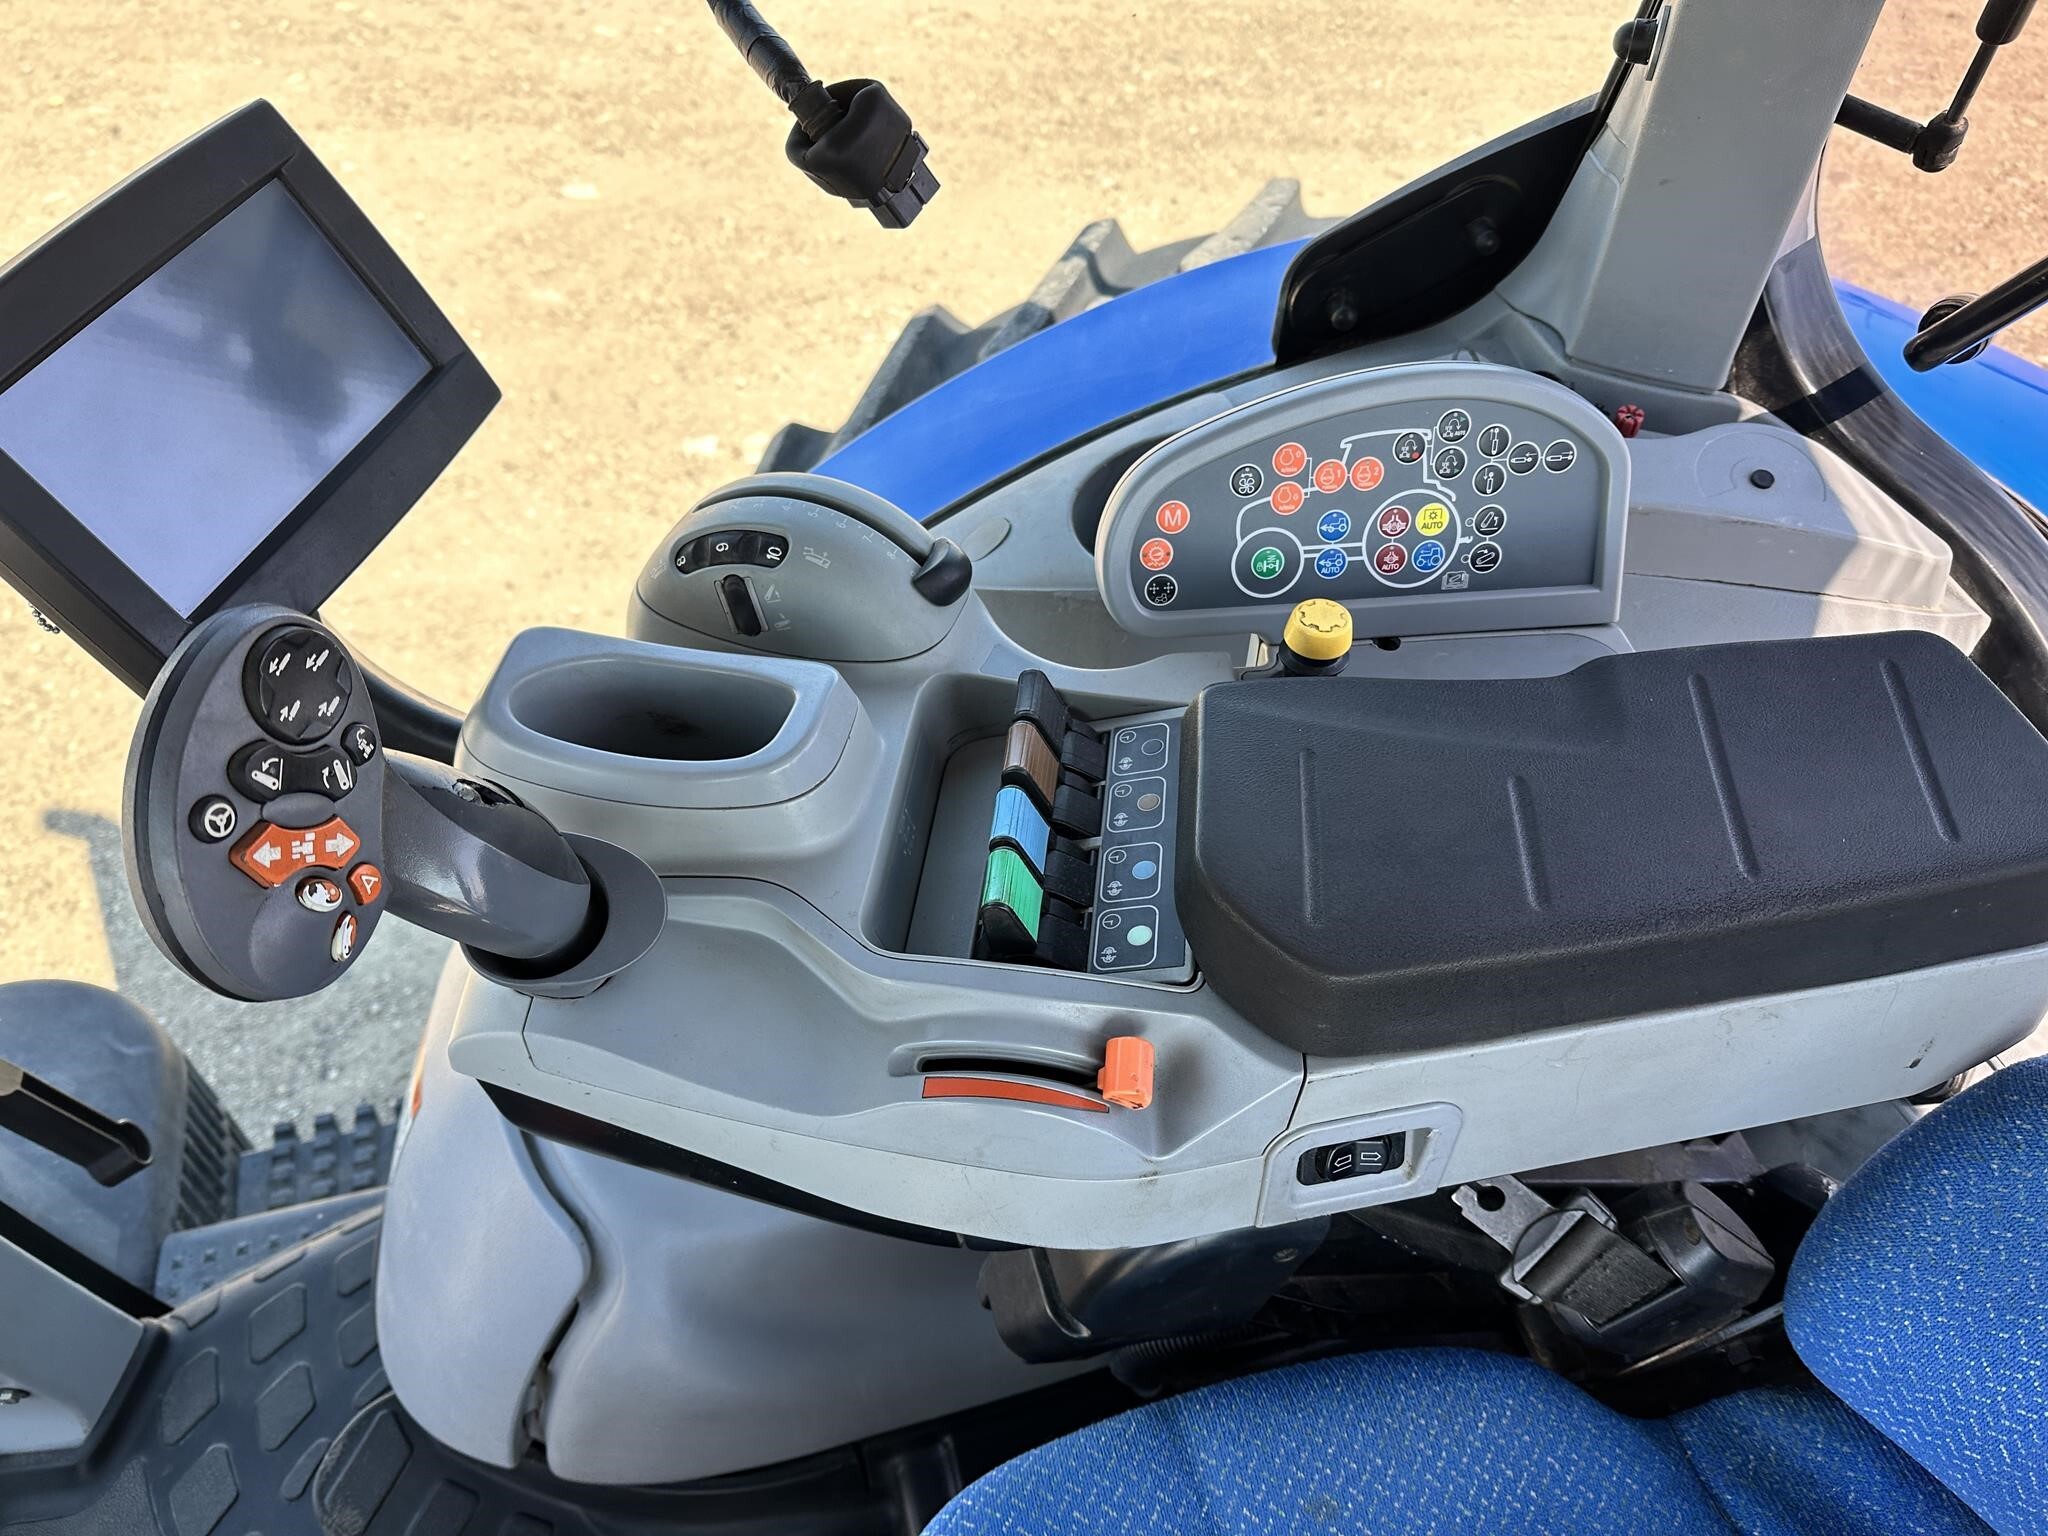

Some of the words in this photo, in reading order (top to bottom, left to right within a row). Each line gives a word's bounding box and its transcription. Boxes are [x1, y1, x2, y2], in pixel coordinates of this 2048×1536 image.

[1373, 467, 1380, 476] 2
[1164, 510, 1182, 527] M
[1421, 521, 1444, 530] AUTO
[766, 546, 783, 561] 10
[676, 555, 687, 567] 8
[1320, 566, 1341, 574] AUTO
[1381, 563, 1400, 571] AUTO
[361, 874, 379, 896] A
